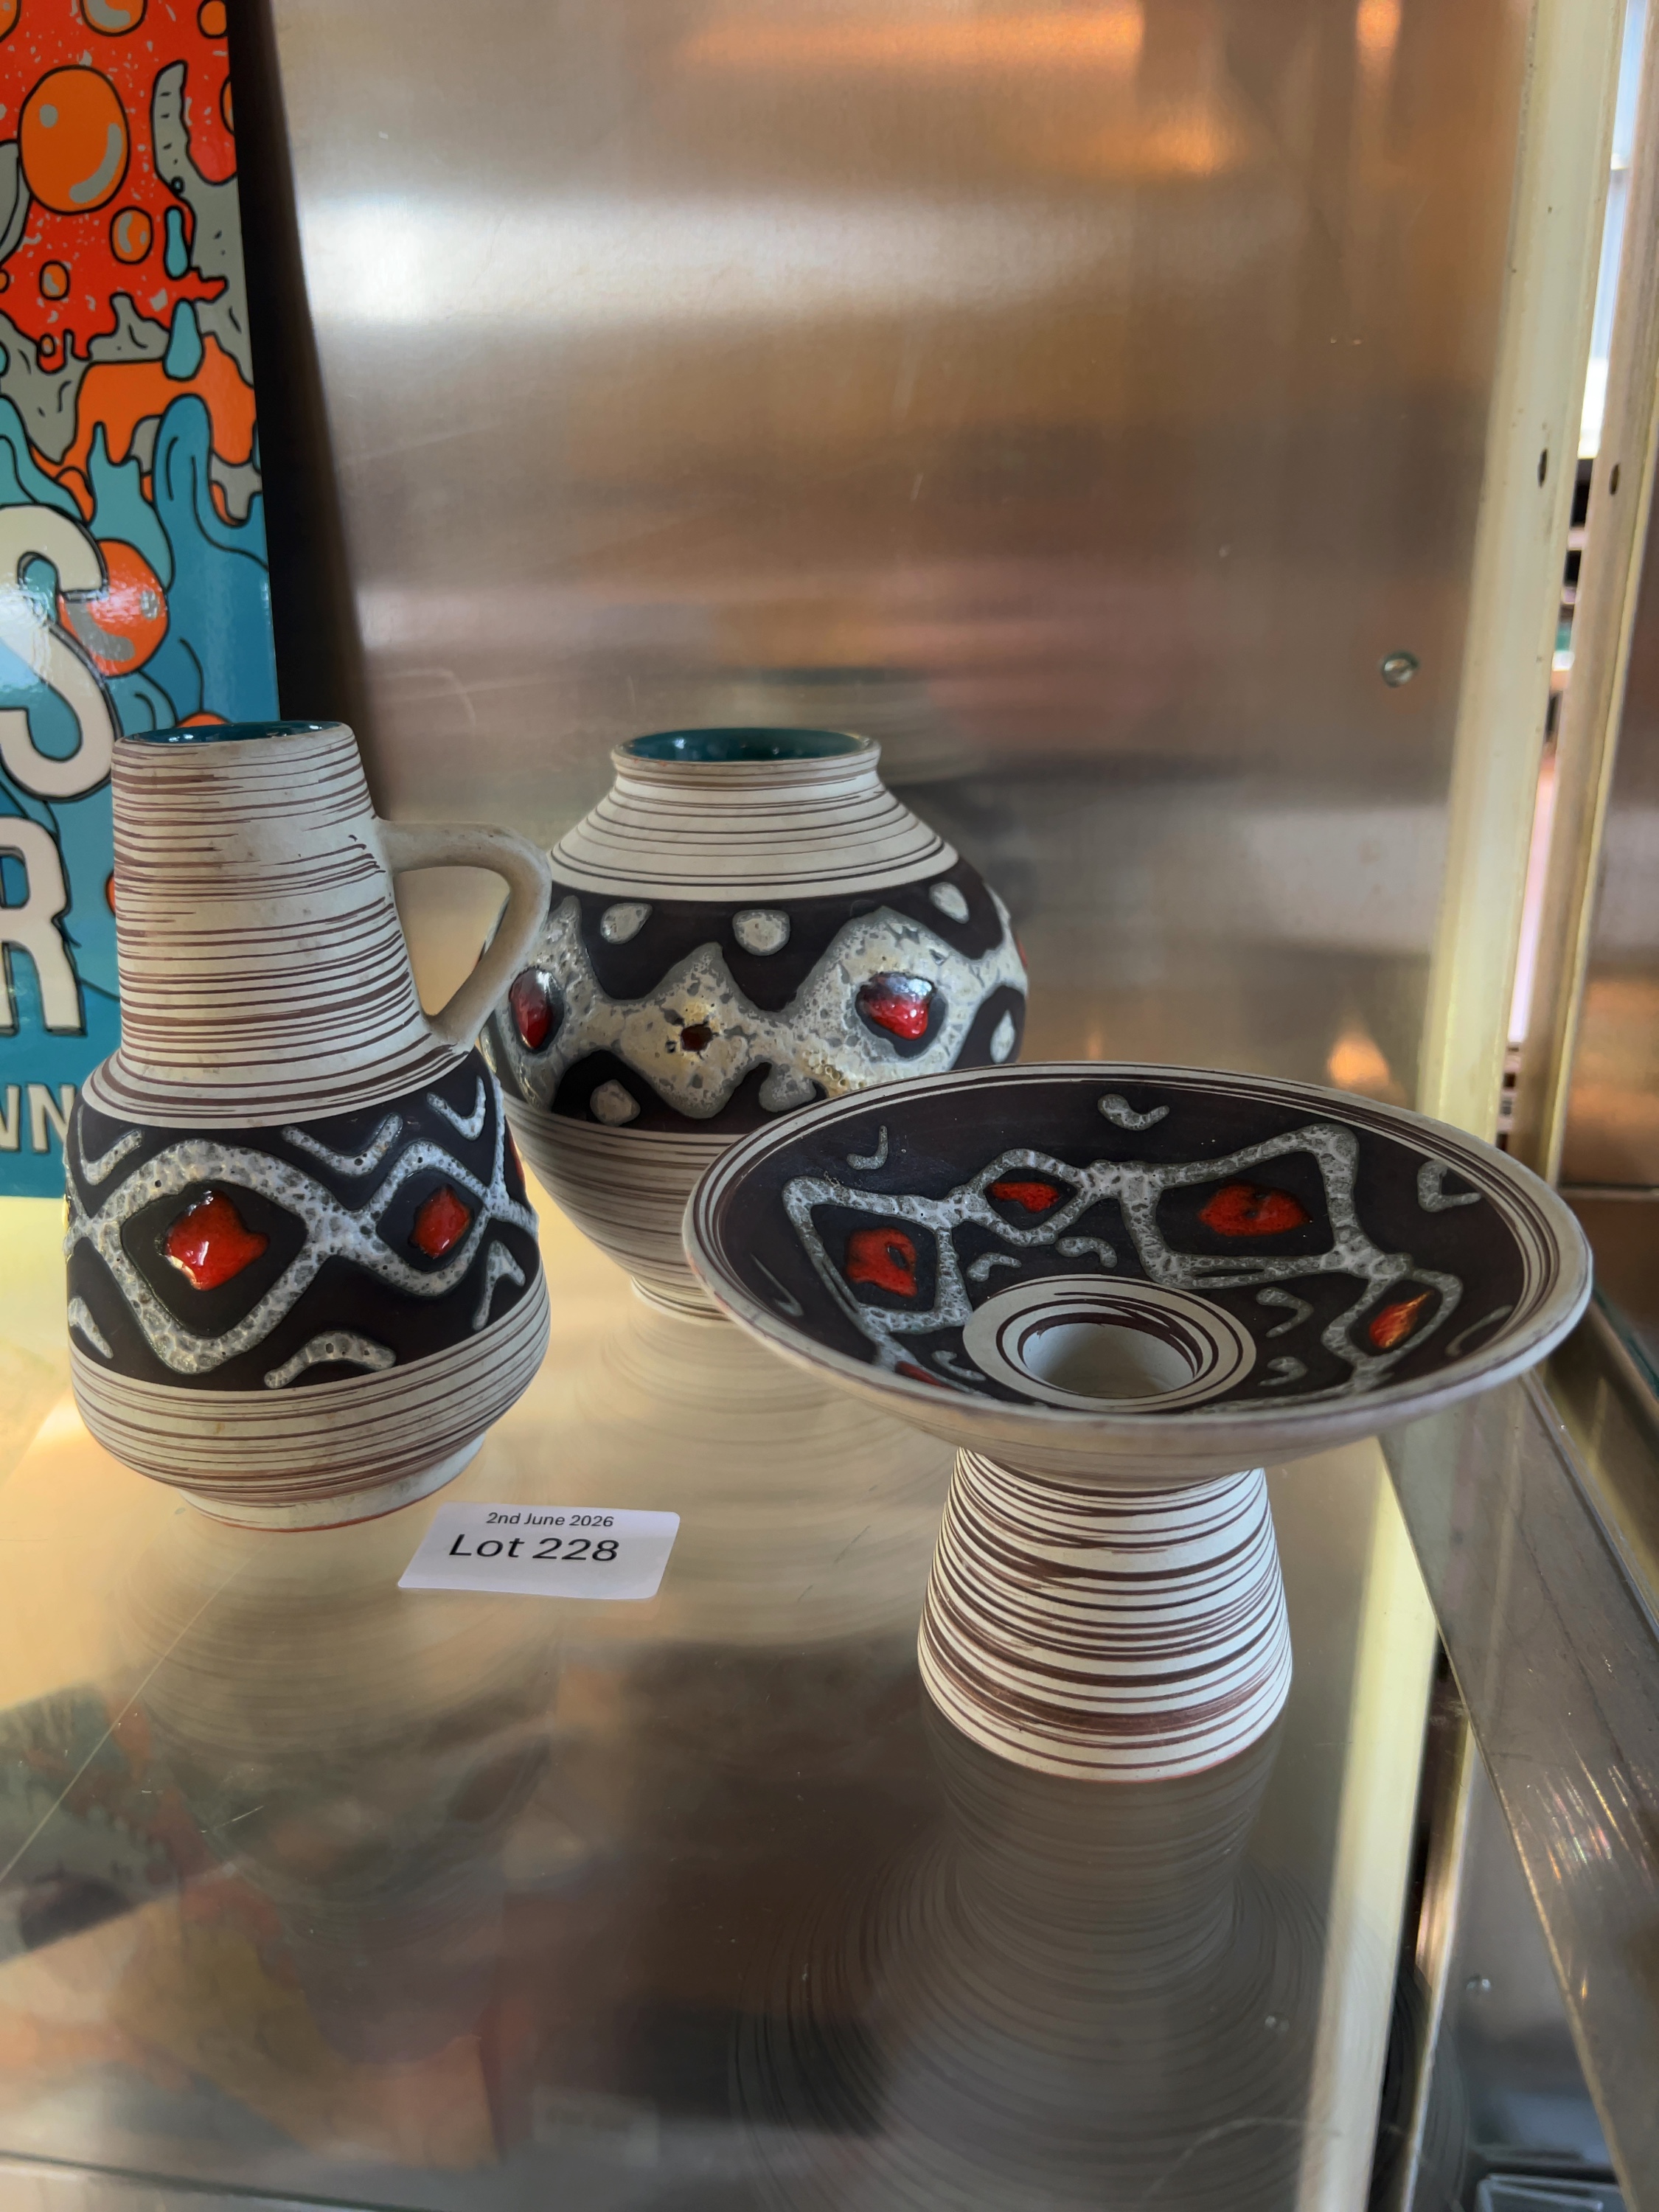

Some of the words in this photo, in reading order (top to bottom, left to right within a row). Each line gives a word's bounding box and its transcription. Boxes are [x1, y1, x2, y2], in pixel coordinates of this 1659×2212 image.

[0, 817, 83, 1033] R
[486, 1512, 521, 1525] 2nd
[524, 1514, 566, 1526] June
[569, 1514, 614, 1527] 2026
[448, 1534, 525, 1558] Lot
[532, 1537, 619, 1562] 228
